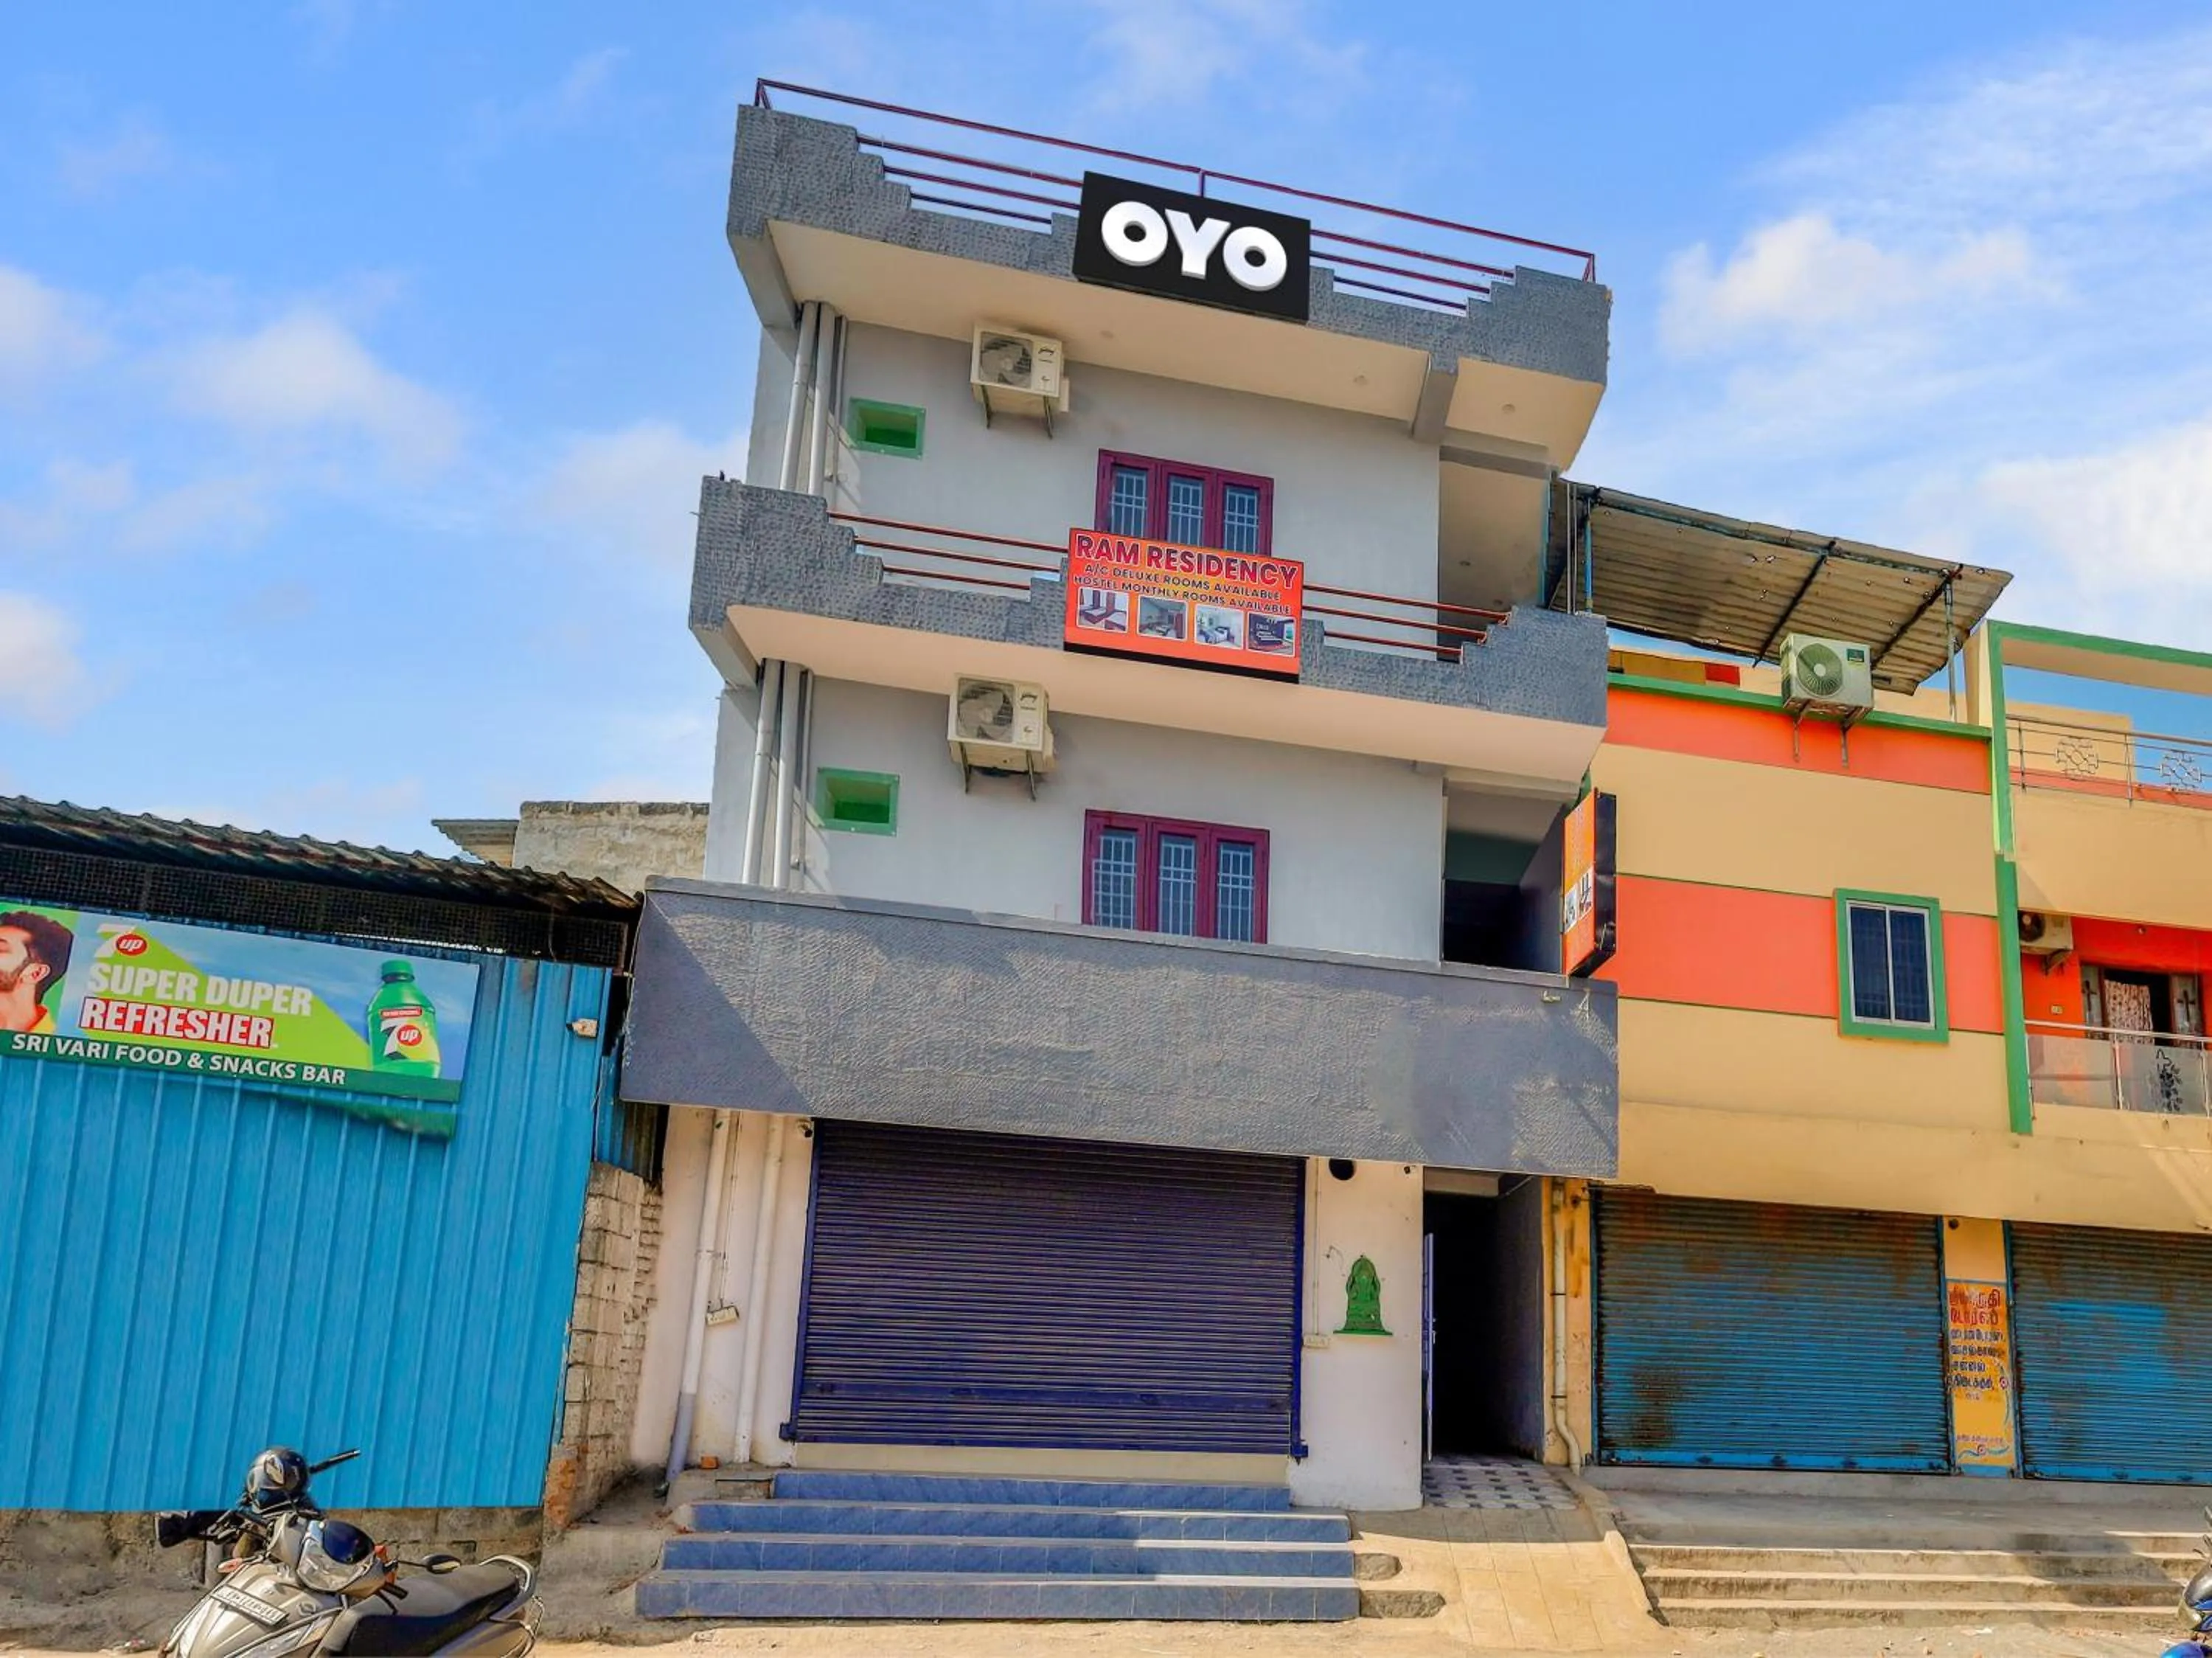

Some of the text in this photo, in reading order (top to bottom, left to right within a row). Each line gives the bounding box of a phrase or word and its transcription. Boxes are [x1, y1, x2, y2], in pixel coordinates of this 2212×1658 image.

[1101, 200, 1287, 292] OYO
[1075, 534, 1298, 589] RAM RESIDENCY
[1085, 563, 1281, 601] A/C DELUXE ROOMS AVAILABLE
[1074, 575, 1291, 614] HOSTEL MONTHLY ROOMS AVAILABLE
[88, 962, 313, 1016] SUPER DUPER
[79, 996, 274, 1049] REFRESHER
[11, 1033, 347, 1085] SRI VARI FOOD & SNACKS BAR
